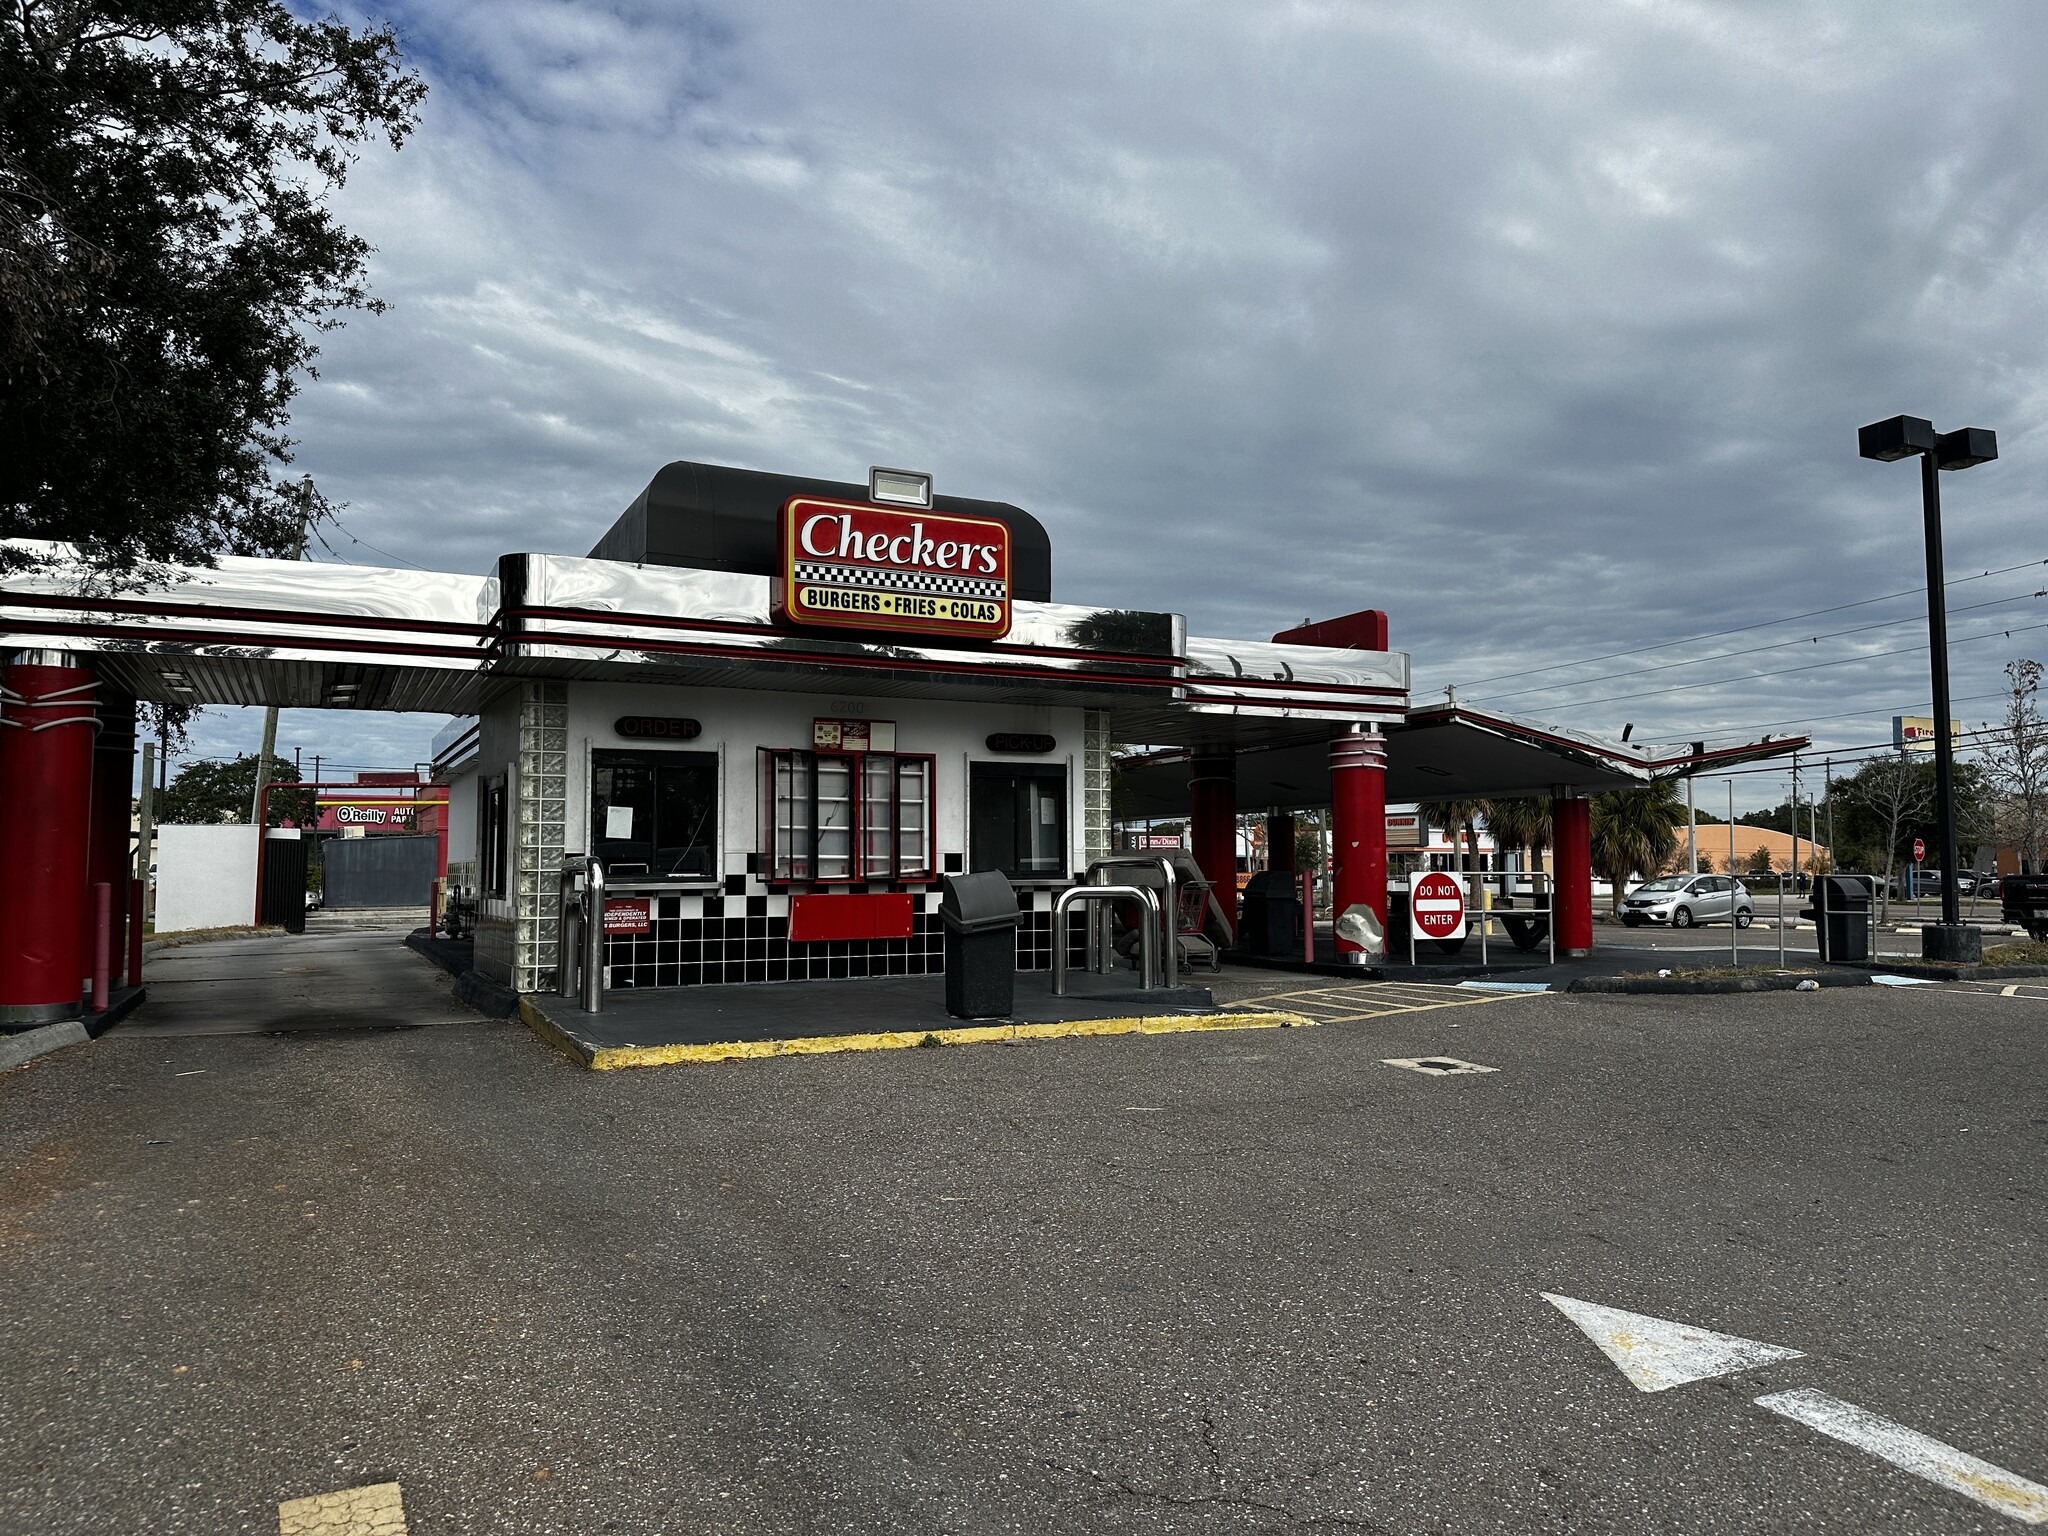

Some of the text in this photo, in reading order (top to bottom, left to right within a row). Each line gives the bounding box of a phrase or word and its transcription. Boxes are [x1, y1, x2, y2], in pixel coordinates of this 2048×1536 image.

[800, 514, 998, 573] Checkers
[807, 588, 995, 621] BURGERS FRIES COLAS
[830, 701, 864, 714] 6200
[624, 718, 696, 736] ORDER
[995, 735, 1053, 750] PICK-UP
[338, 807, 386, 824] O'Reilly
[1419, 885, 1456, 896] DO NOT
[1424, 914, 1454, 925] ENTER
